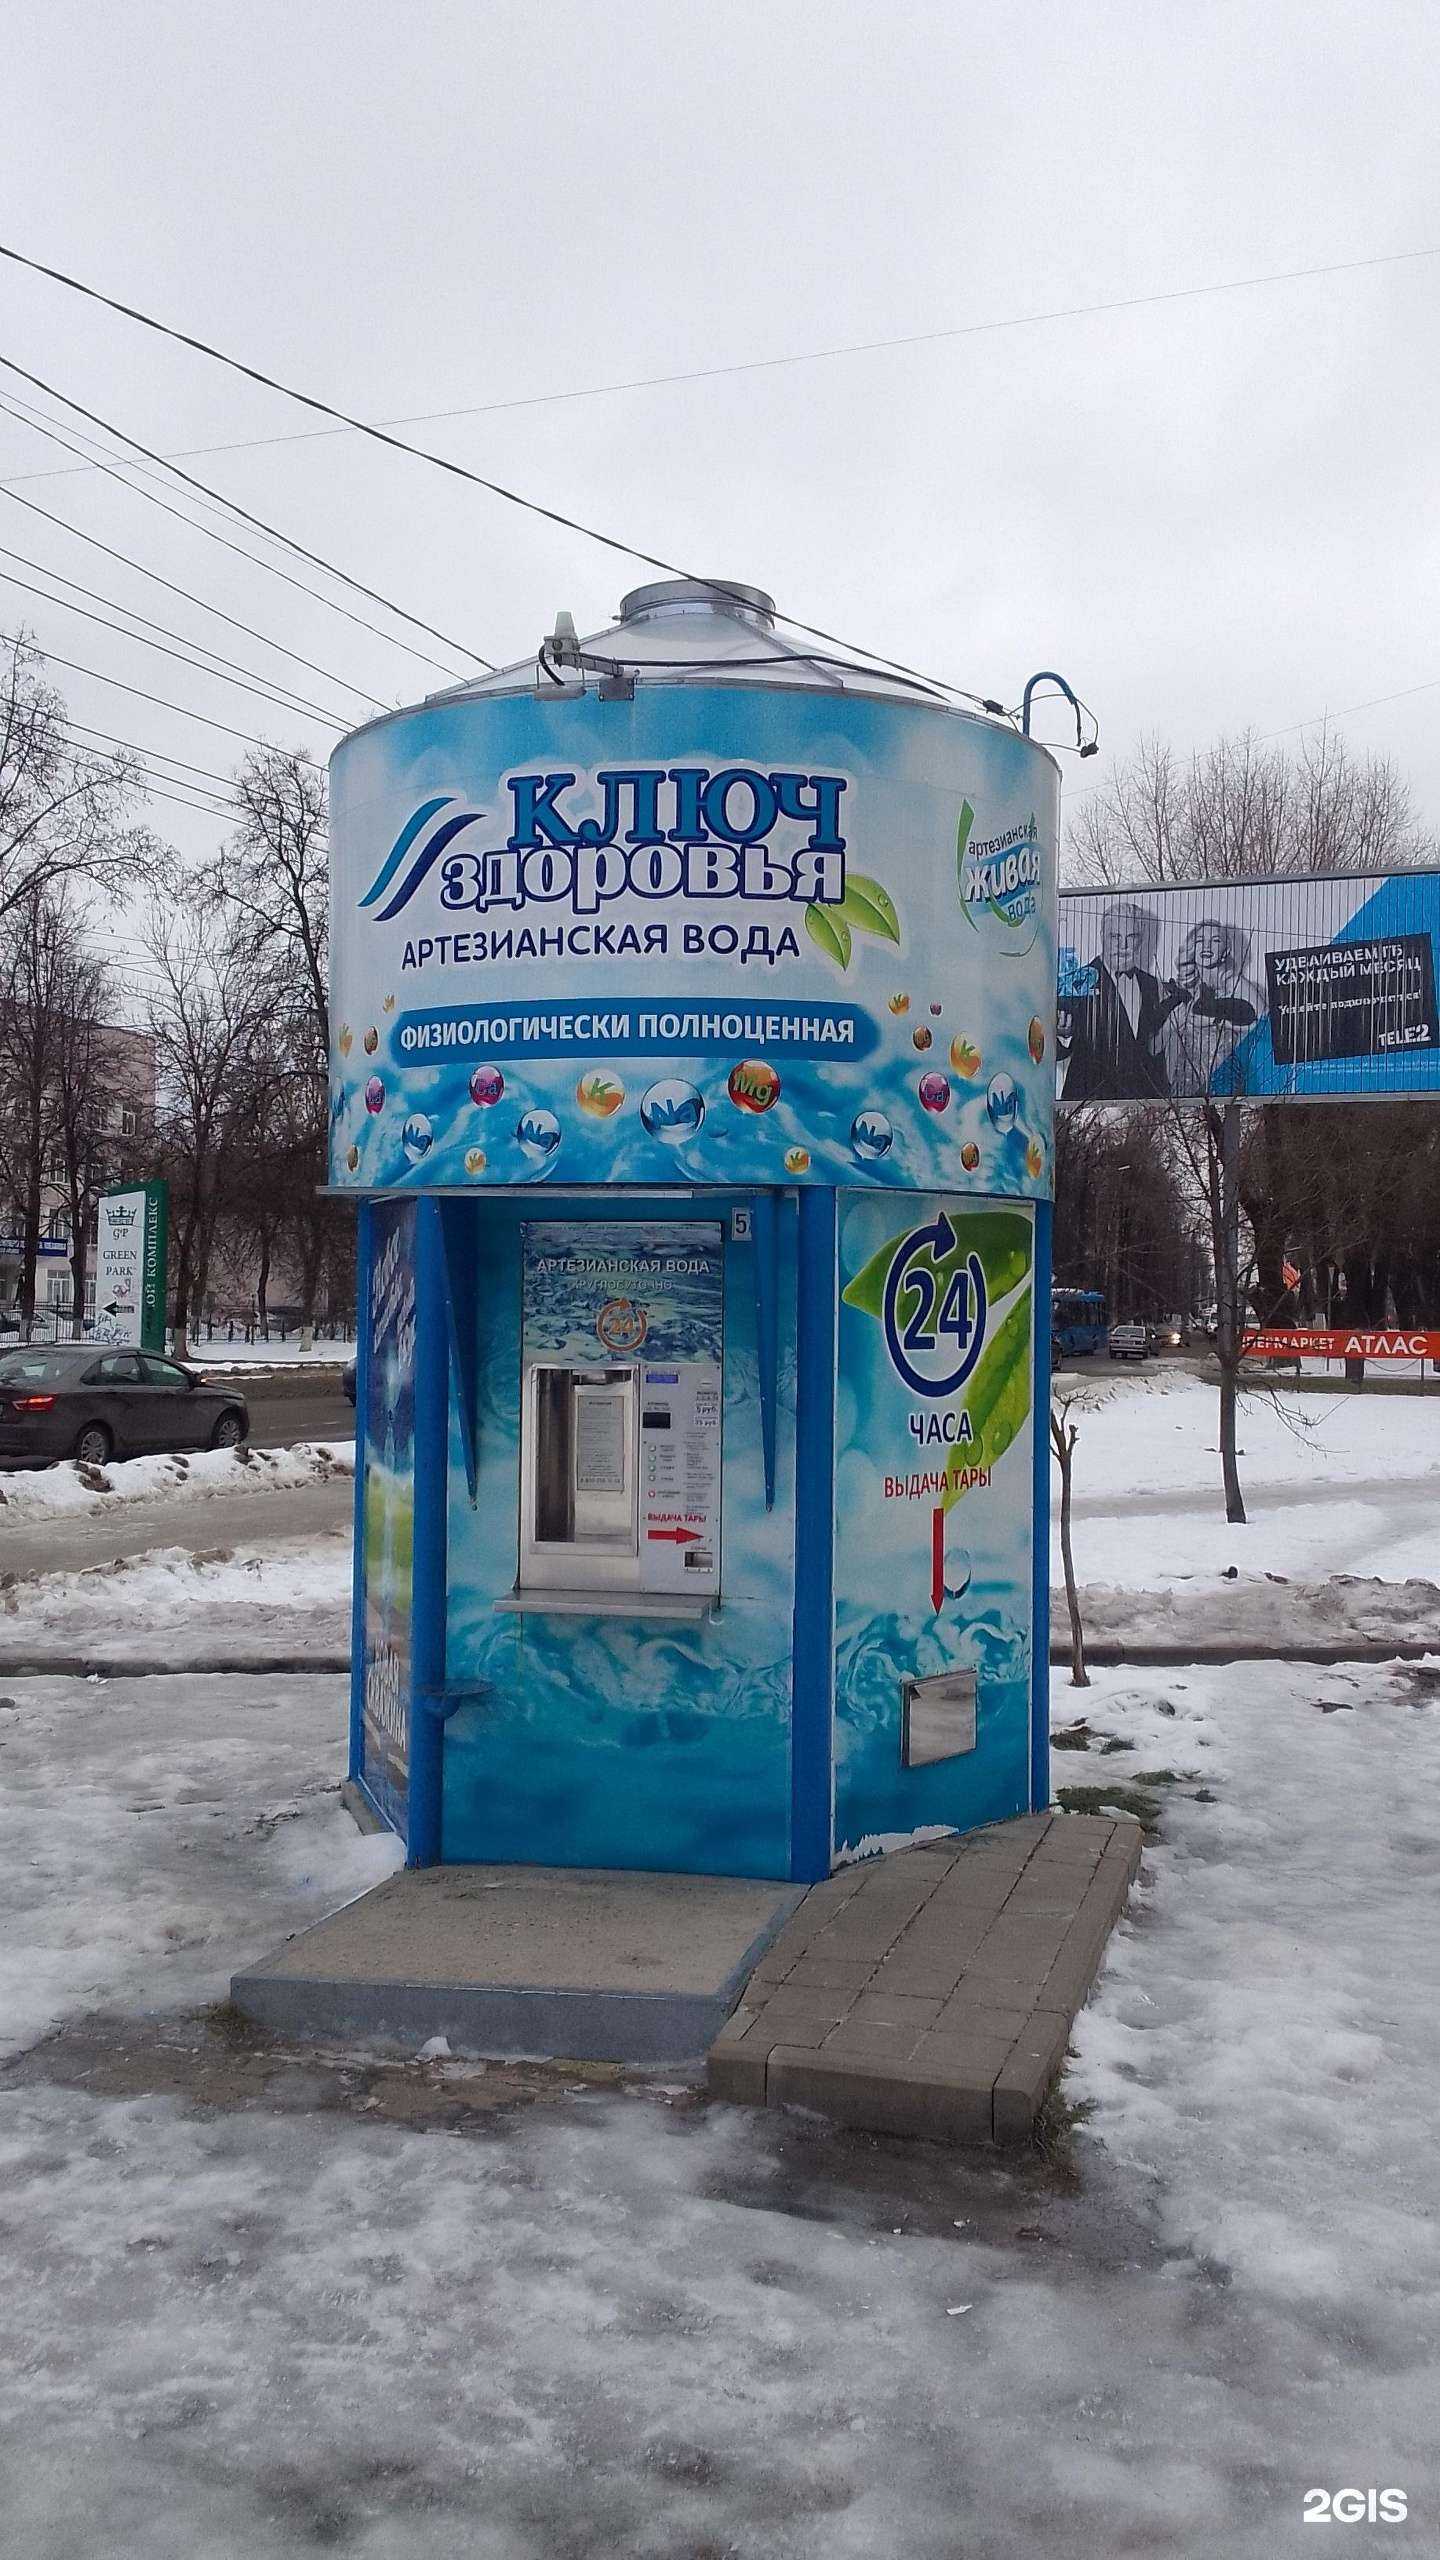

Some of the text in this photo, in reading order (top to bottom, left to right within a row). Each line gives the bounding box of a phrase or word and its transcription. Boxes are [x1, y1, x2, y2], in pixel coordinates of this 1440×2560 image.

[507, 768, 847, 851] КЛЮЧ
[402, 924, 800, 971] АРТЕЗИАНСКАЯ ВОДА
[1276, 963, 1356, 986] КАЖДЫЙ
[401, 1014, 629, 1052] ФИЗИОЛОГИЧЕСКИ
[638, 1013, 855, 1045] ПОЛНОЦЕННАЯ
[1378, 1024, 1432, 1047] TELE2
[733, 1071, 772, 1105] Mg
[146, 1197, 159, 1277] КОМПЛЕКС
[735, 1213, 747, 1234] 5
[103, 1250, 137, 1260] GREEN
[537, 1259, 710, 1274] АРТЕЗИАНСКАЯ ВОДА
[105, 1266, 134, 1276] PARK
[903, 1268, 973, 1350] 24
[1344, 1335, 1429, 1355] АТЛАС
[910, 1411, 973, 1445] ЧАСА
[884, 1466, 993, 1500] ВЫДАЧА ТАРЫ
[647, 1512, 707, 1523] ВЫДАЧА ТАРЫ
